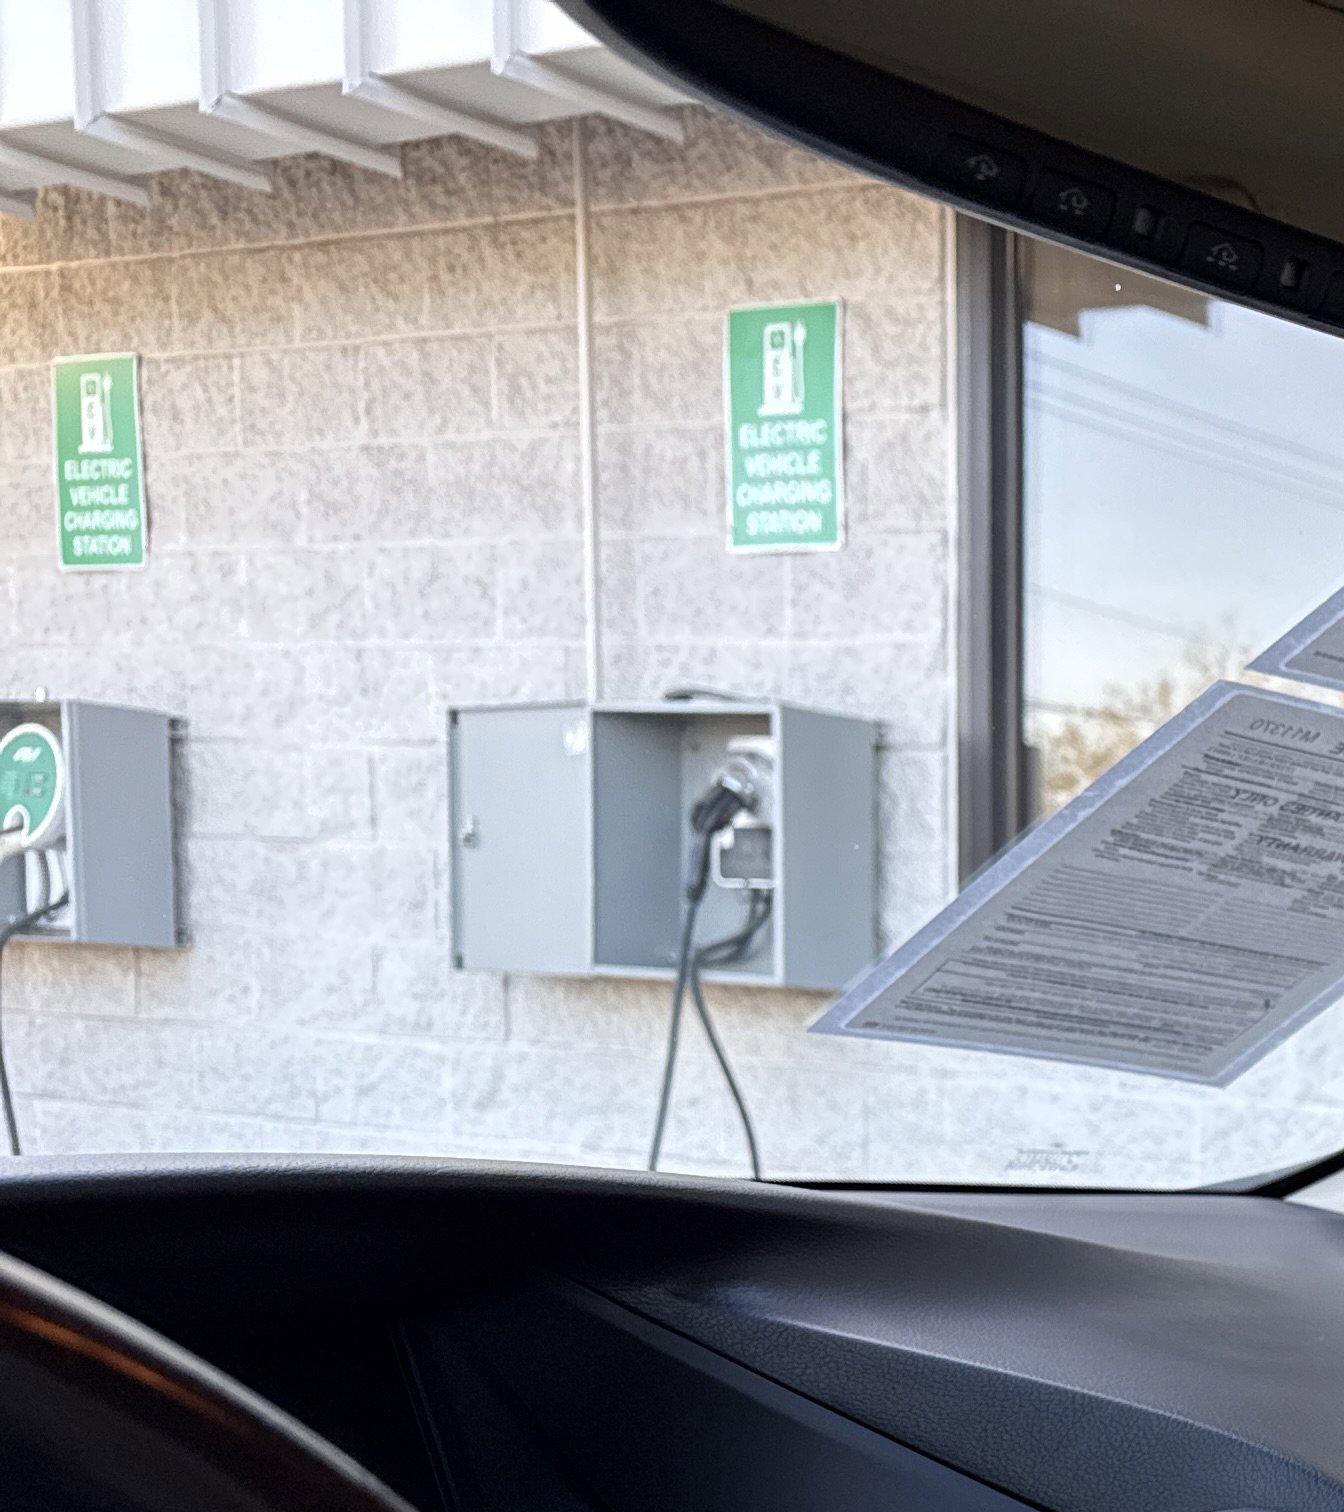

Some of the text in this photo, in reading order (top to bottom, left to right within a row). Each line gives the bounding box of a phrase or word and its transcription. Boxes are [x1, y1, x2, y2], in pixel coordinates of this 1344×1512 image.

[739, 419, 827, 447] ELECTRIC
[64, 458, 132, 481] ELECTRIC
[744, 451, 821, 477] VEHICLE
[69, 484, 129, 506] VEHICLE
[736, 479, 832, 507] CHARGING
[64, 509, 139, 532] CHARGING
[746, 510, 822, 536] STATION
[73, 534, 132, 556] STATION
